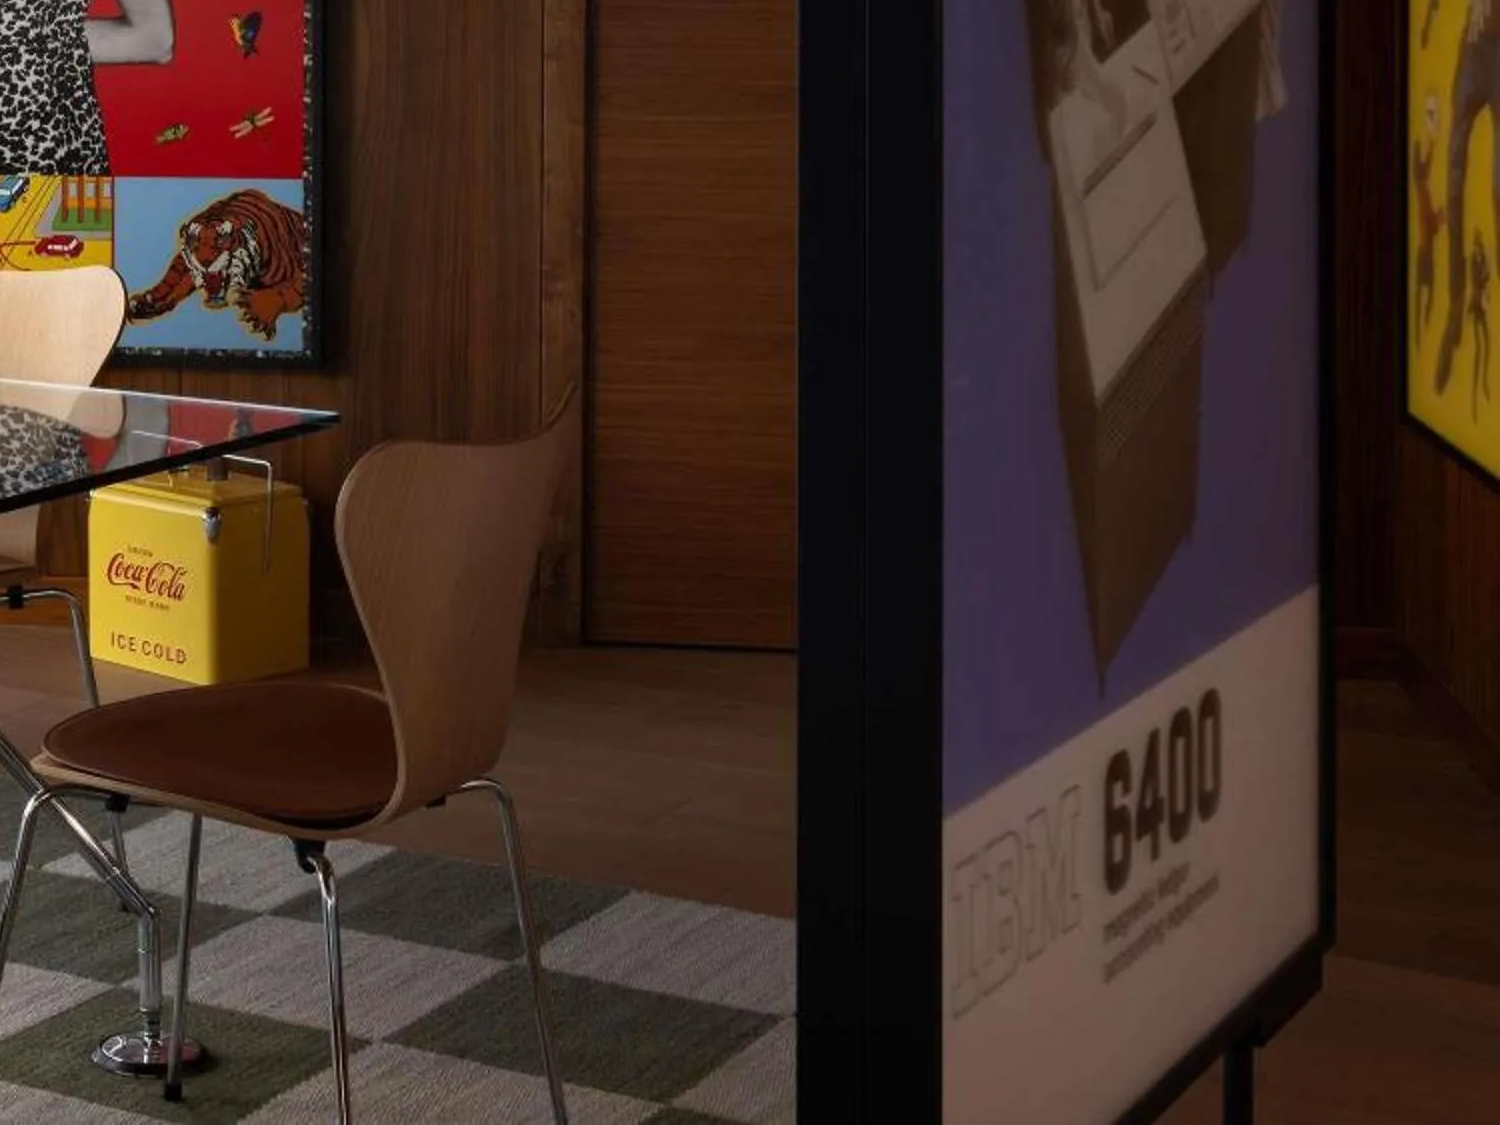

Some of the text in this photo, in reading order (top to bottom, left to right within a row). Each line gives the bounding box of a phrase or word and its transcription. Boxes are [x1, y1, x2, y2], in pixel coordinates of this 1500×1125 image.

[107, 552, 187, 601] Coca-Cola
[110, 631, 187, 664] ICE COLD
[951, 784, 1082, 1021] IBM
[1104, 687, 1222, 895] 6400
